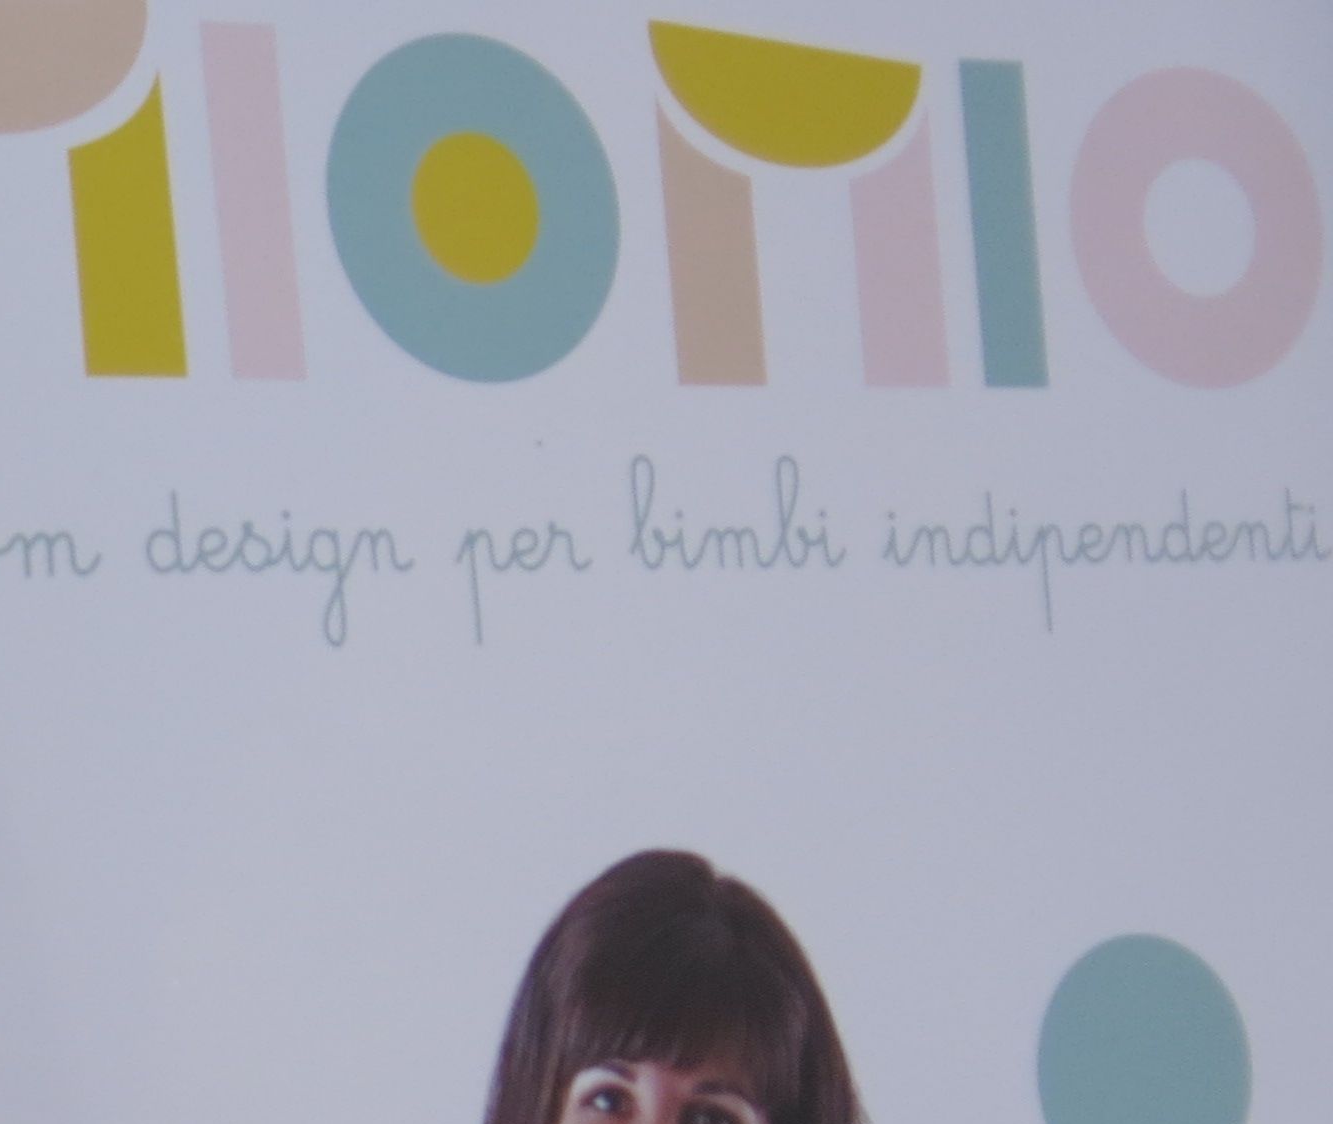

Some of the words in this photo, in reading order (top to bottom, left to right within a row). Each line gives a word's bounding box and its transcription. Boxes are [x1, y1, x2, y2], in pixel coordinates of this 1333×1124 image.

[144, 488, 415, 648] design
[455, 518, 594, 647] per
[628, 453, 847, 571] bimbi
[881, 486, 1333, 634] indipendenti
